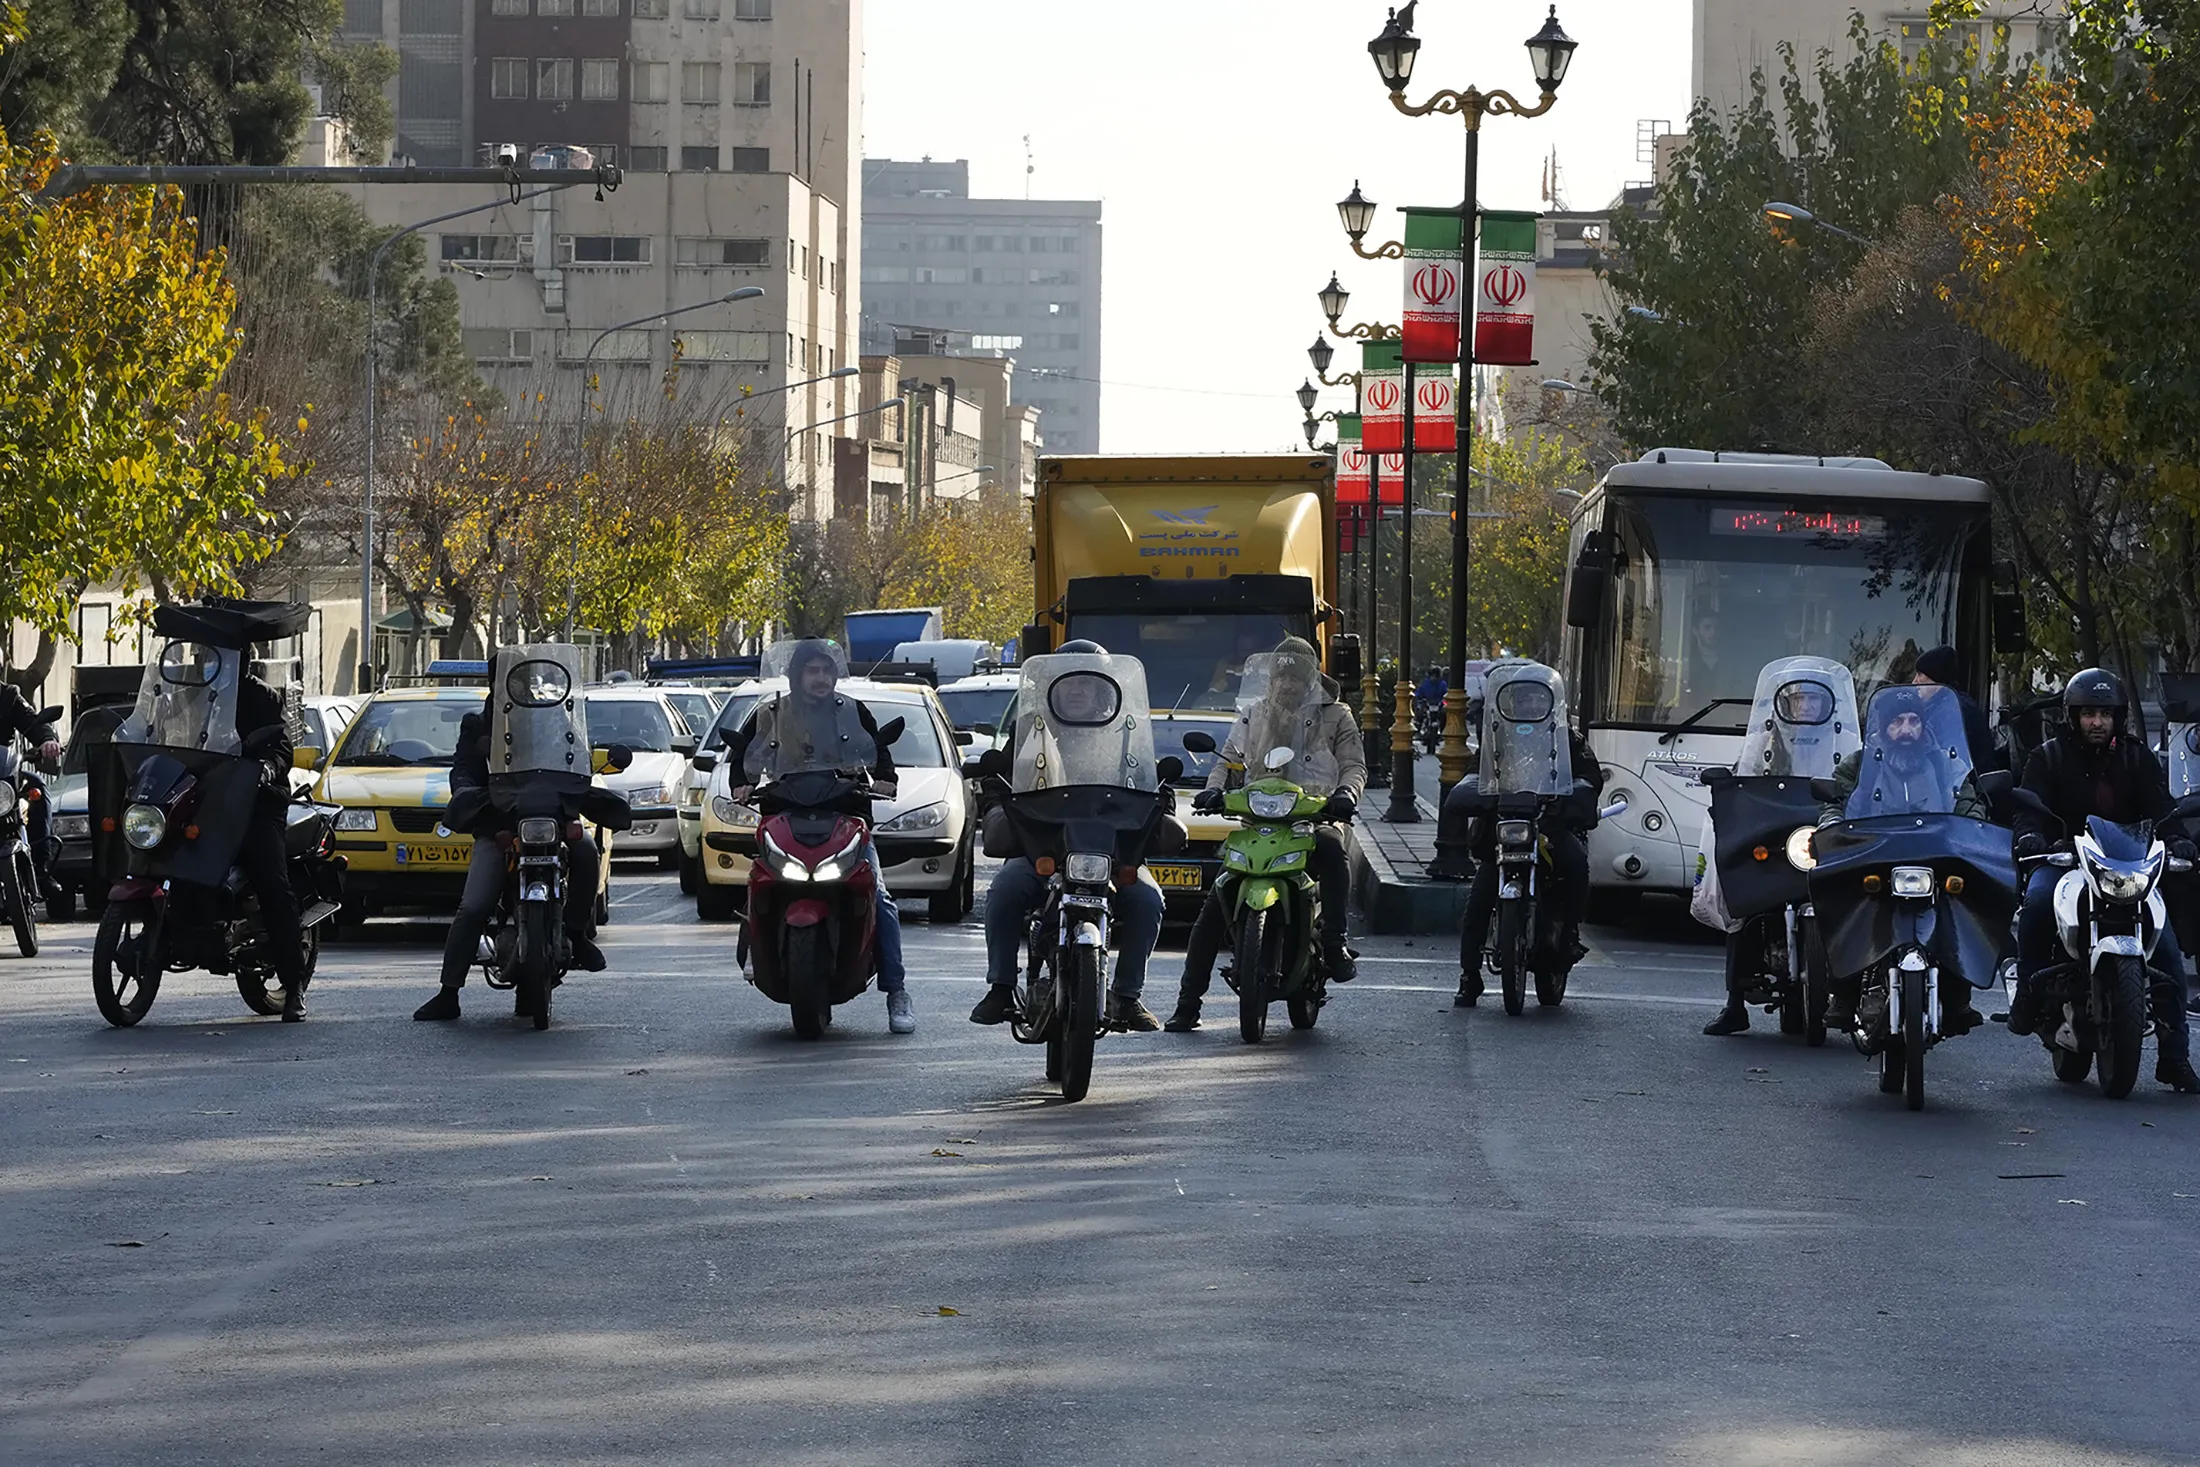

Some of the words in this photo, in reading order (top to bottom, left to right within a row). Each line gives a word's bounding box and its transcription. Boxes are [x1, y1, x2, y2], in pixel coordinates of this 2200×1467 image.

[1170, 529, 1196, 540] ملی
[1139, 546, 1239, 557] BAHMAN
[1647, 750, 1698, 761] ATROS
